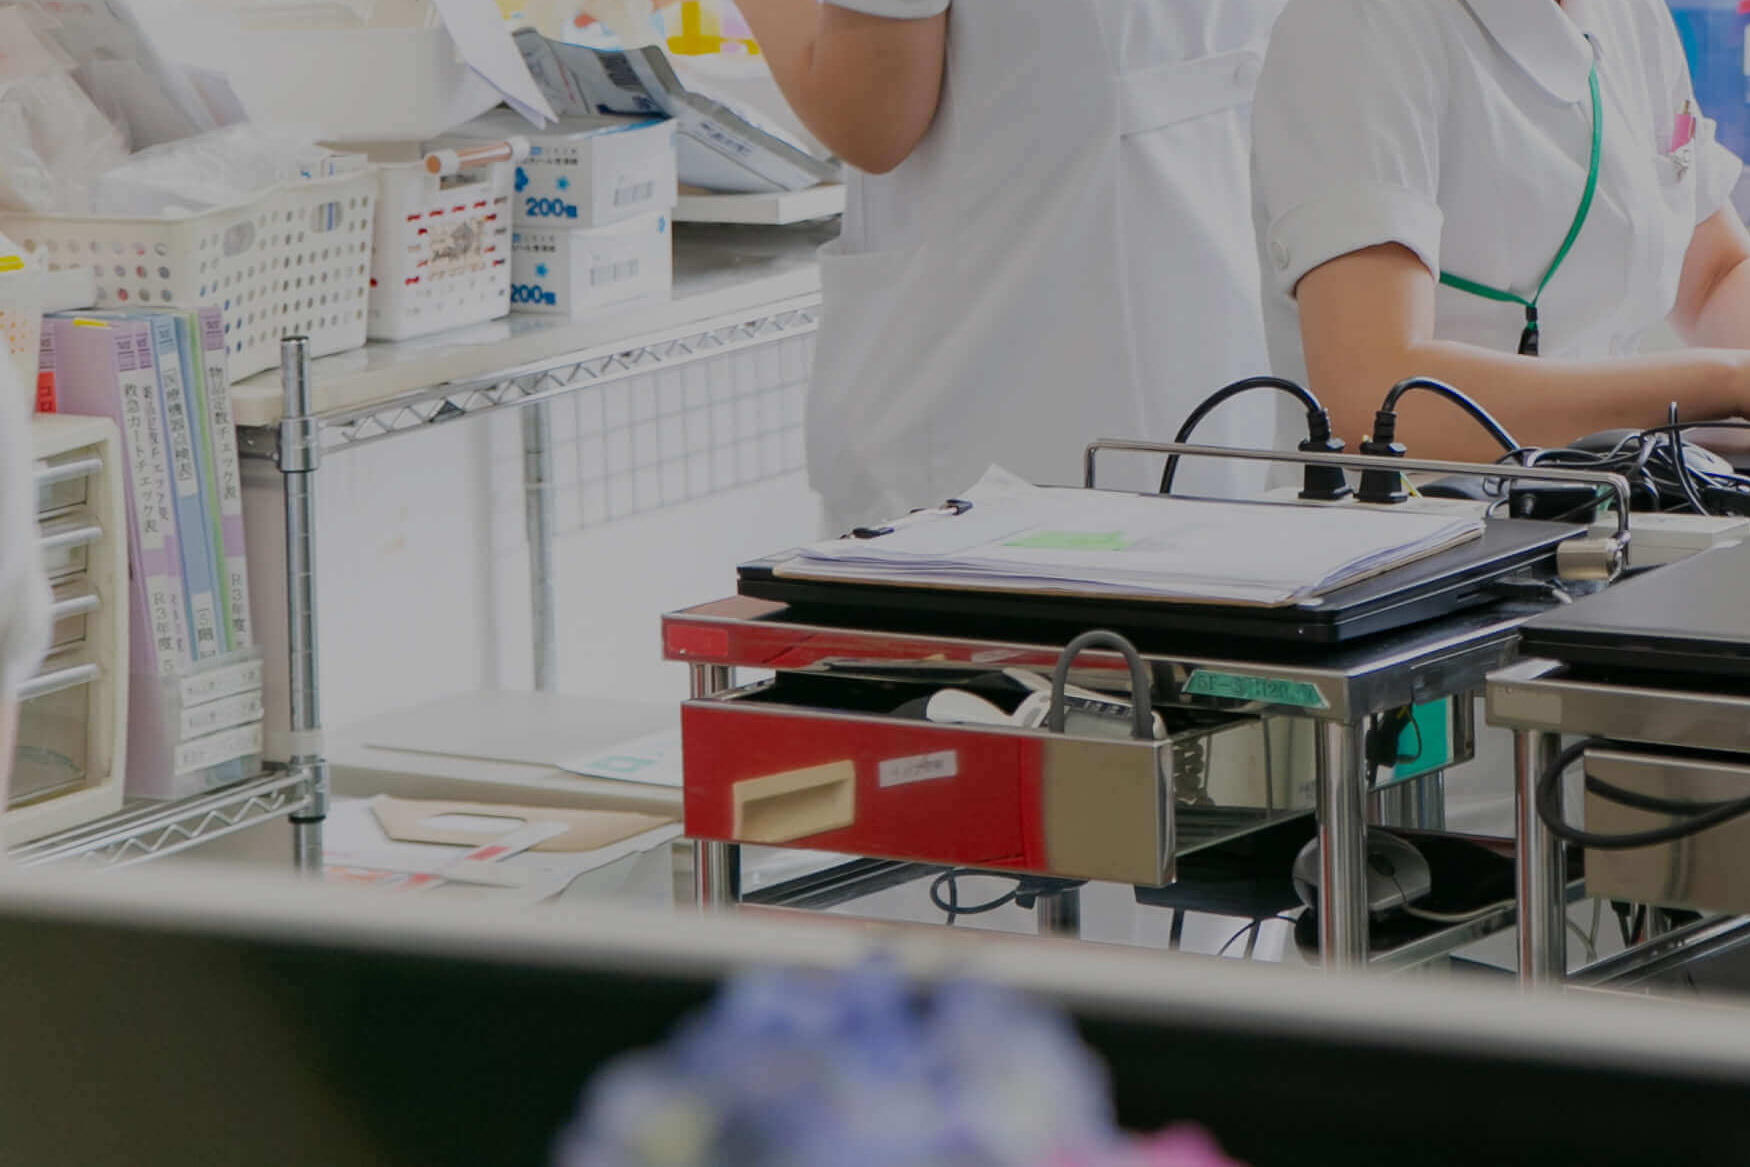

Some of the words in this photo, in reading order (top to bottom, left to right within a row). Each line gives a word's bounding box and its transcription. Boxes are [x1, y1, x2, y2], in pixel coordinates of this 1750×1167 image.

[123, 383, 159, 533] 救急カートチェック表
[208, 366, 237, 499] 物品定数チェック表
[153, 592, 173, 651] R3年度
[231, 573, 247, 633] R3年度
